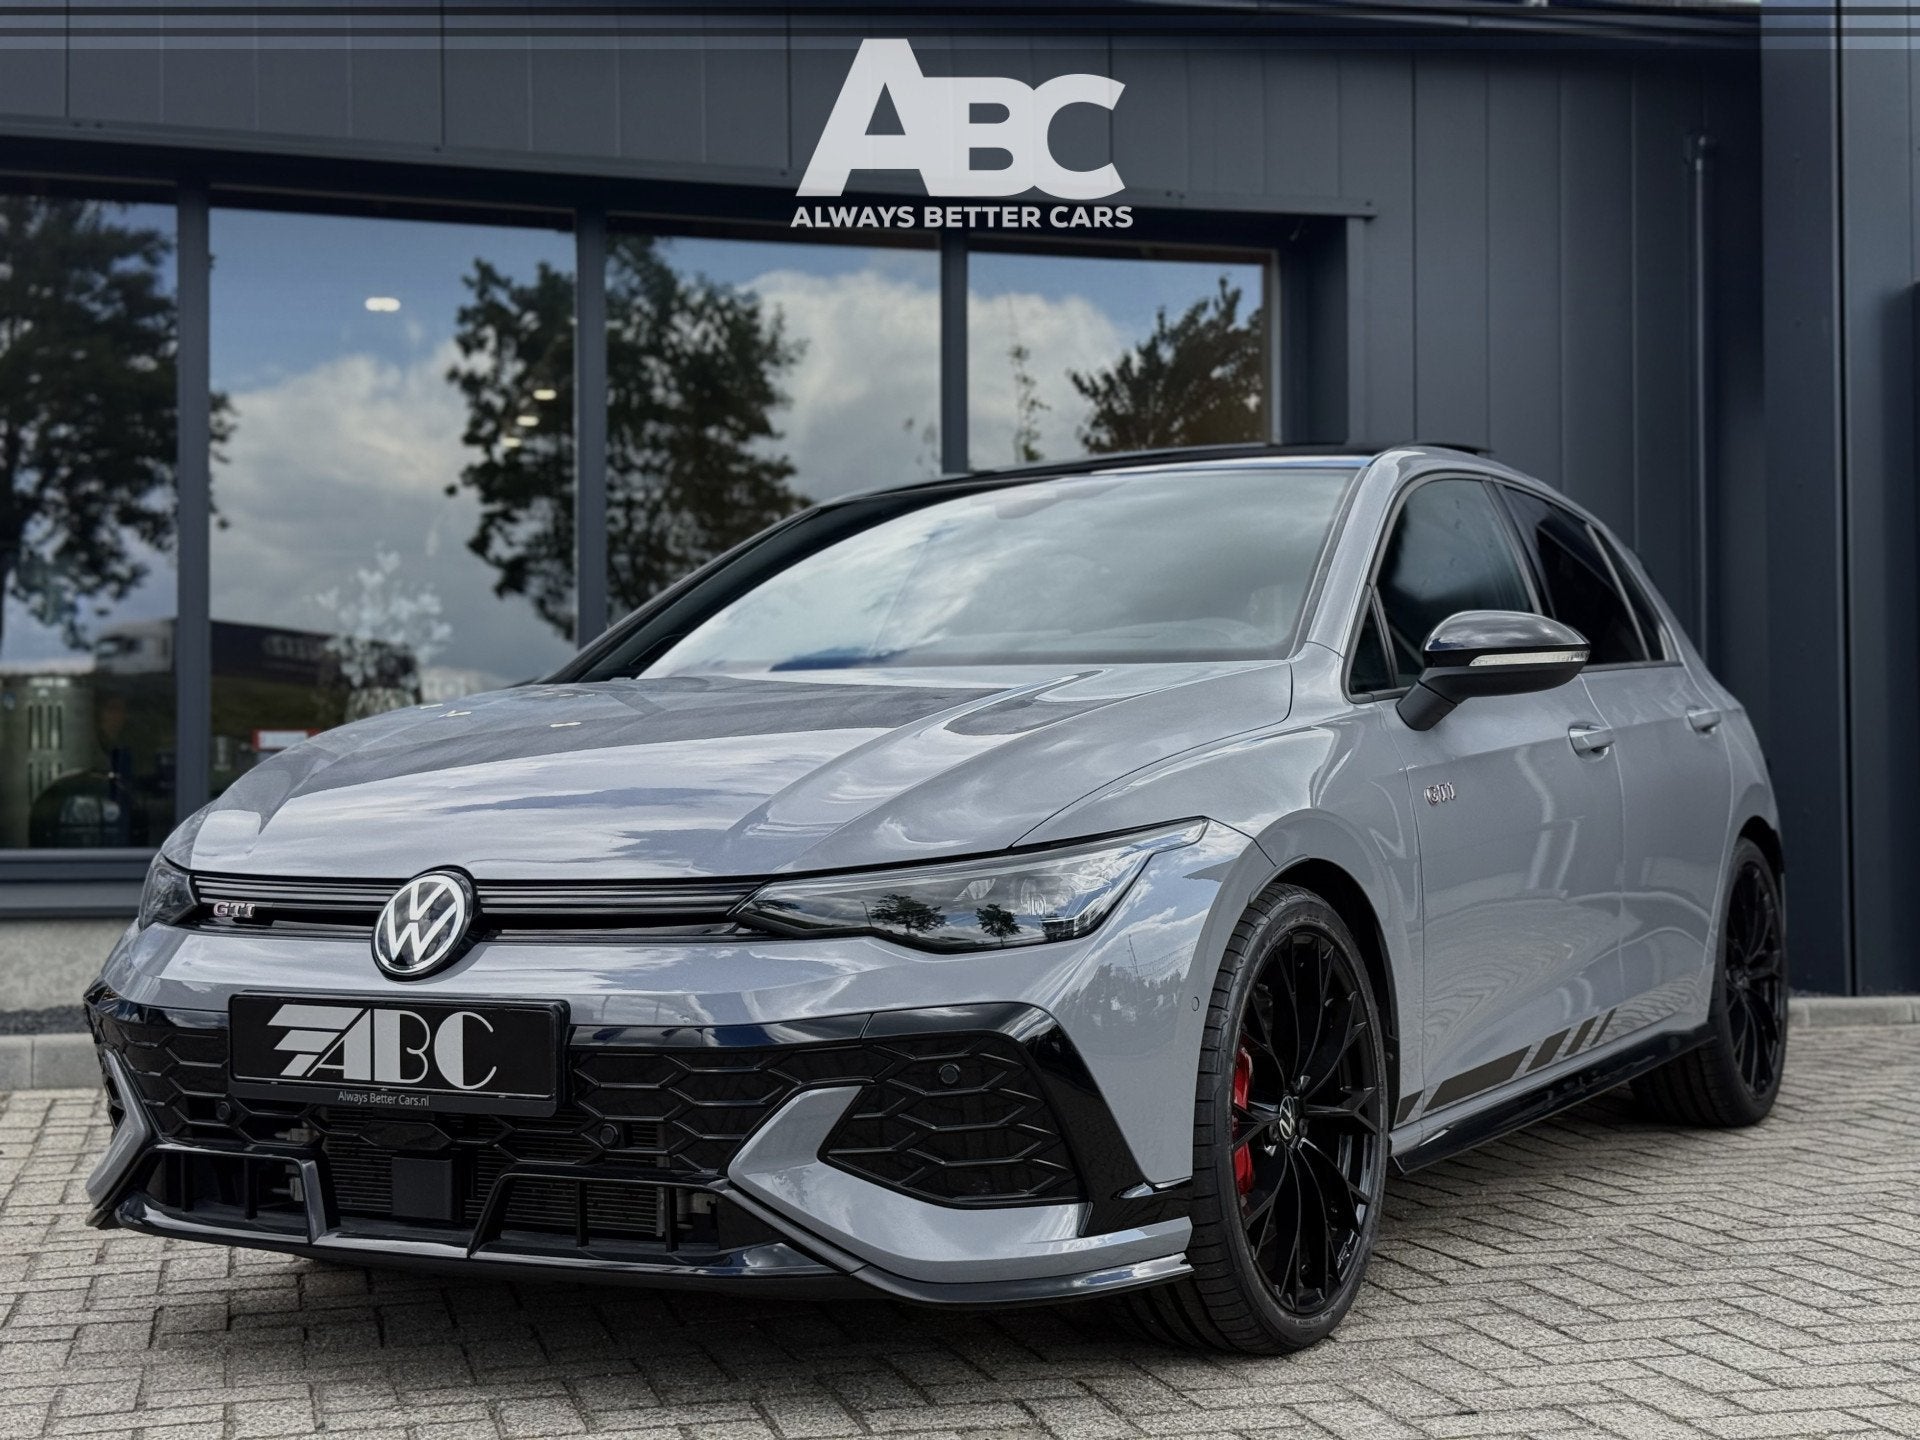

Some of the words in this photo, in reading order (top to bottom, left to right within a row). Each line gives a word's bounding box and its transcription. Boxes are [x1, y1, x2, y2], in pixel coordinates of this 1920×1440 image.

[213, 901, 256, 918] GTI
[306, 1007, 497, 1090] ABC
[338, 1091, 368, 1105] Always
[369, 1093, 397, 1105] Better
[399, 1095, 430, 1107] Cars.nl
